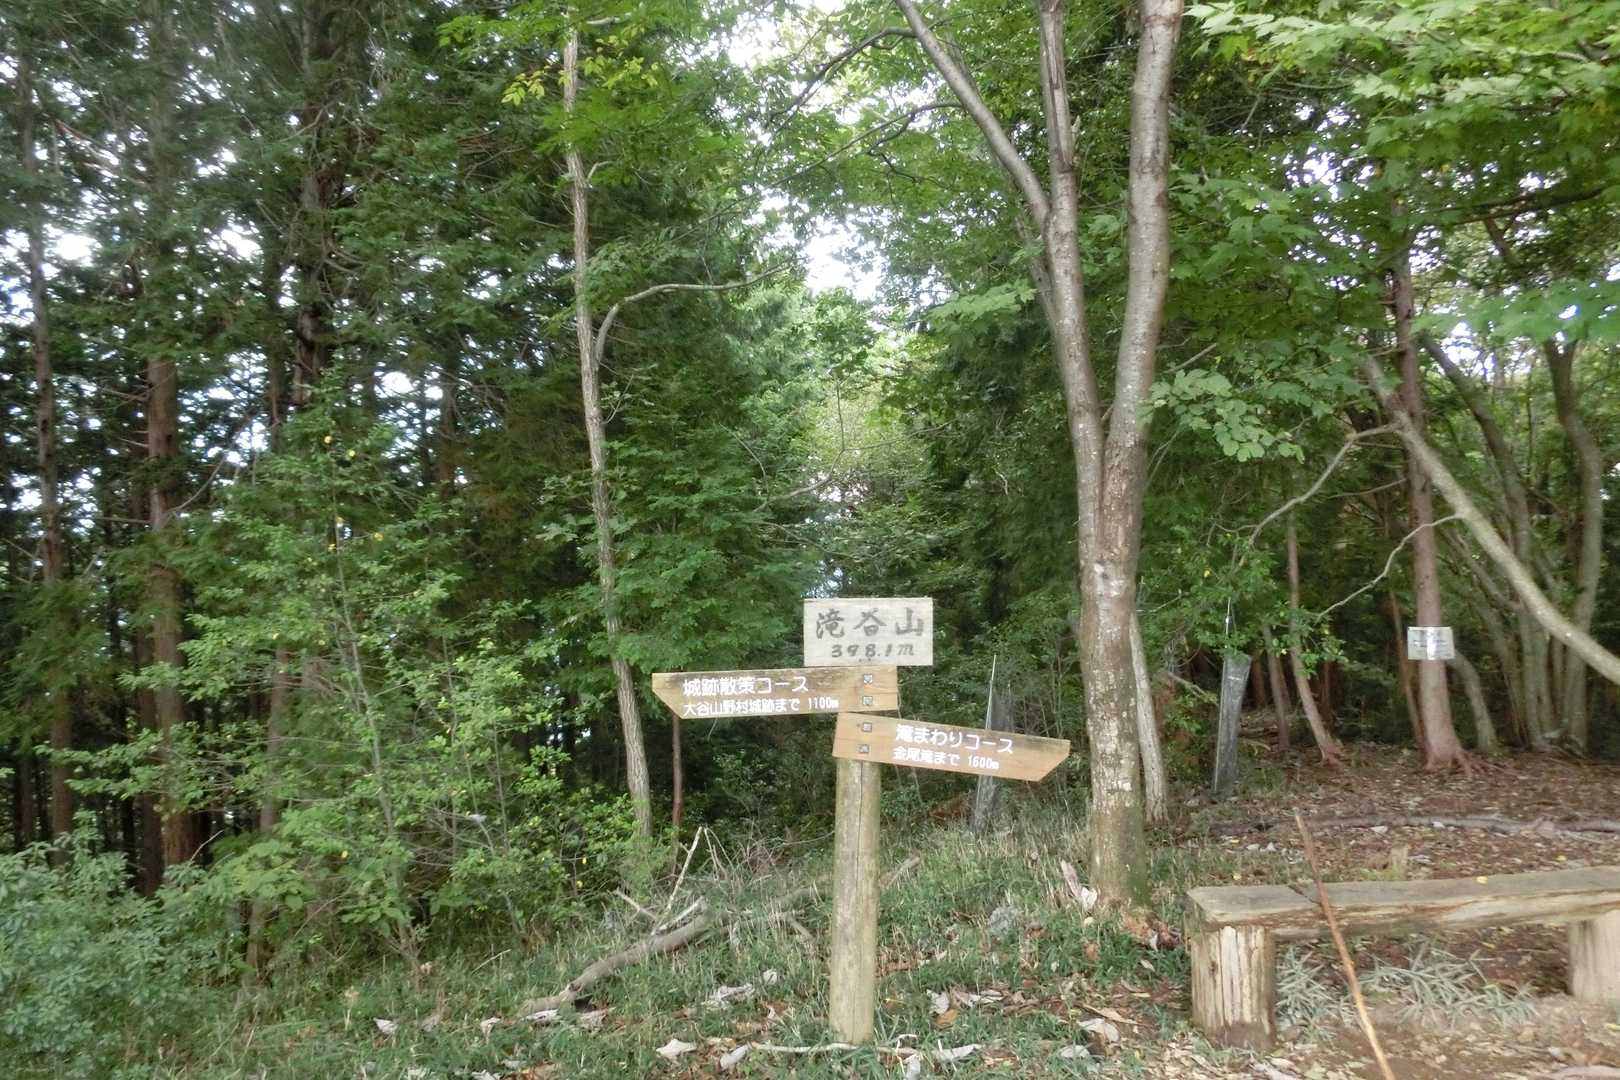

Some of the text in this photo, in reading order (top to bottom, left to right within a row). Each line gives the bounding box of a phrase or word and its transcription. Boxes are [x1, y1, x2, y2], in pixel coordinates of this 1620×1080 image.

[816, 607, 924, 639] 滝谷山
[683, 676, 809, 697] 城跡散策コース
[967, 755, 999, 770] 1600m
